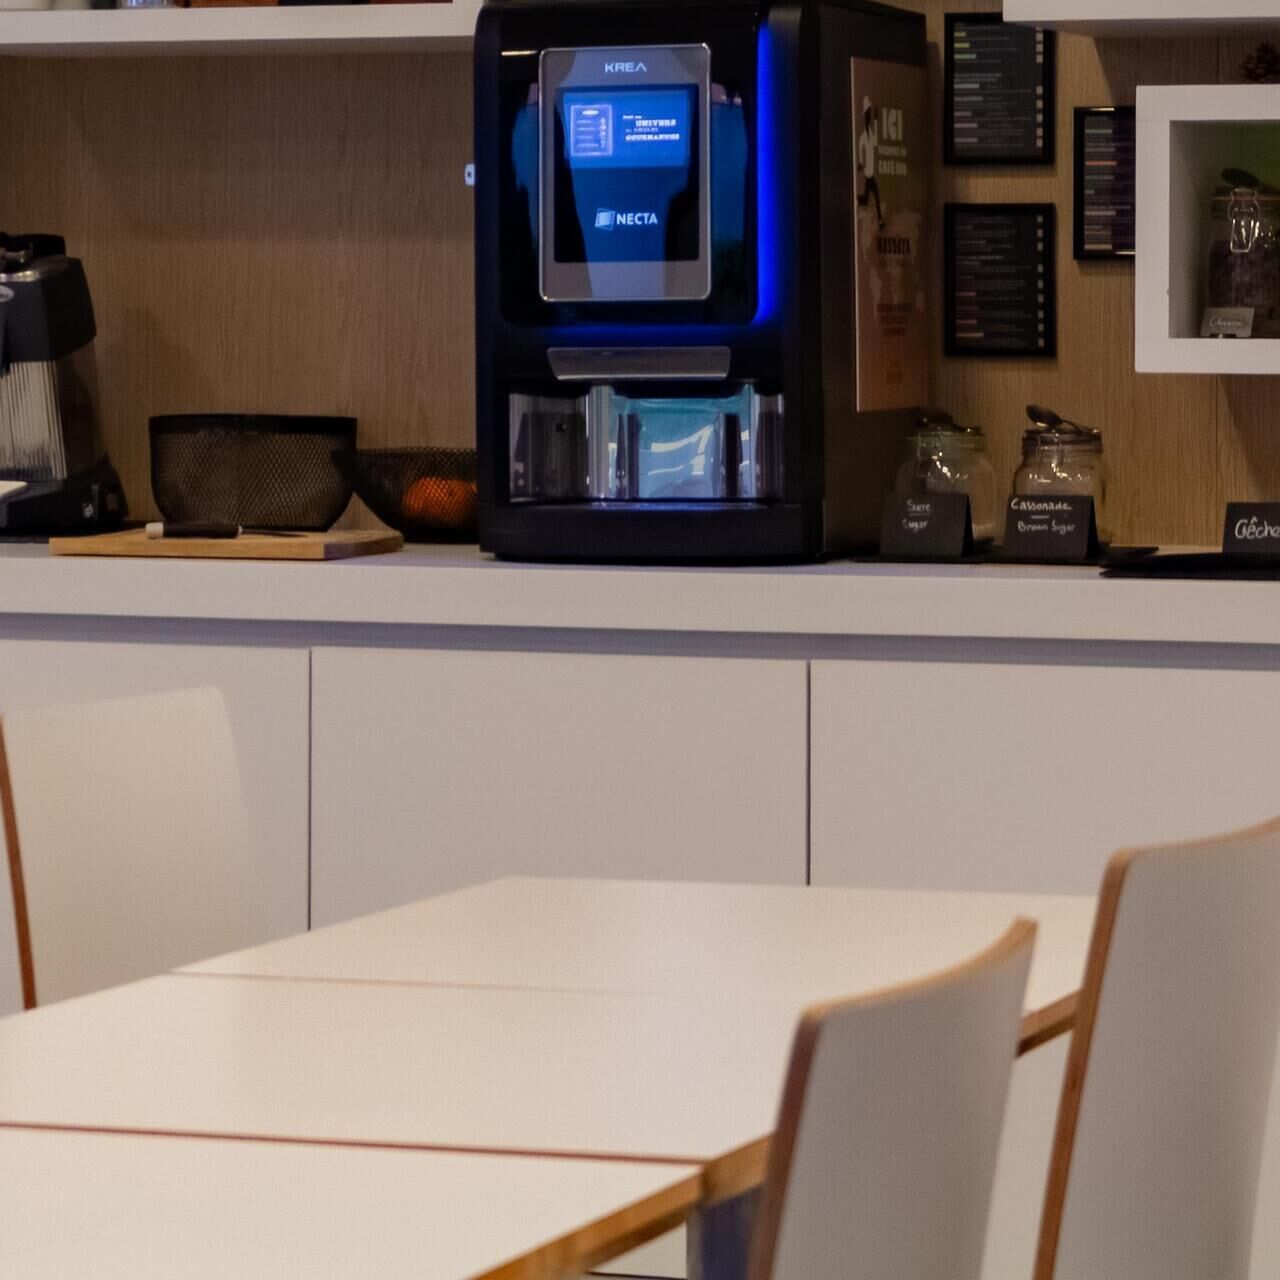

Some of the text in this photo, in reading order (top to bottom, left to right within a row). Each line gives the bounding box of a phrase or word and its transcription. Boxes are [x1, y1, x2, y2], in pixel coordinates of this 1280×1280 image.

[605, 61, 648, 73] KREA
[635, 119, 677, 128] UNIVERS
[881, 107, 903, 141] ICI
[616, 212, 658, 225] NECTA
[1010, 497, 1072, 511] Cassonade
